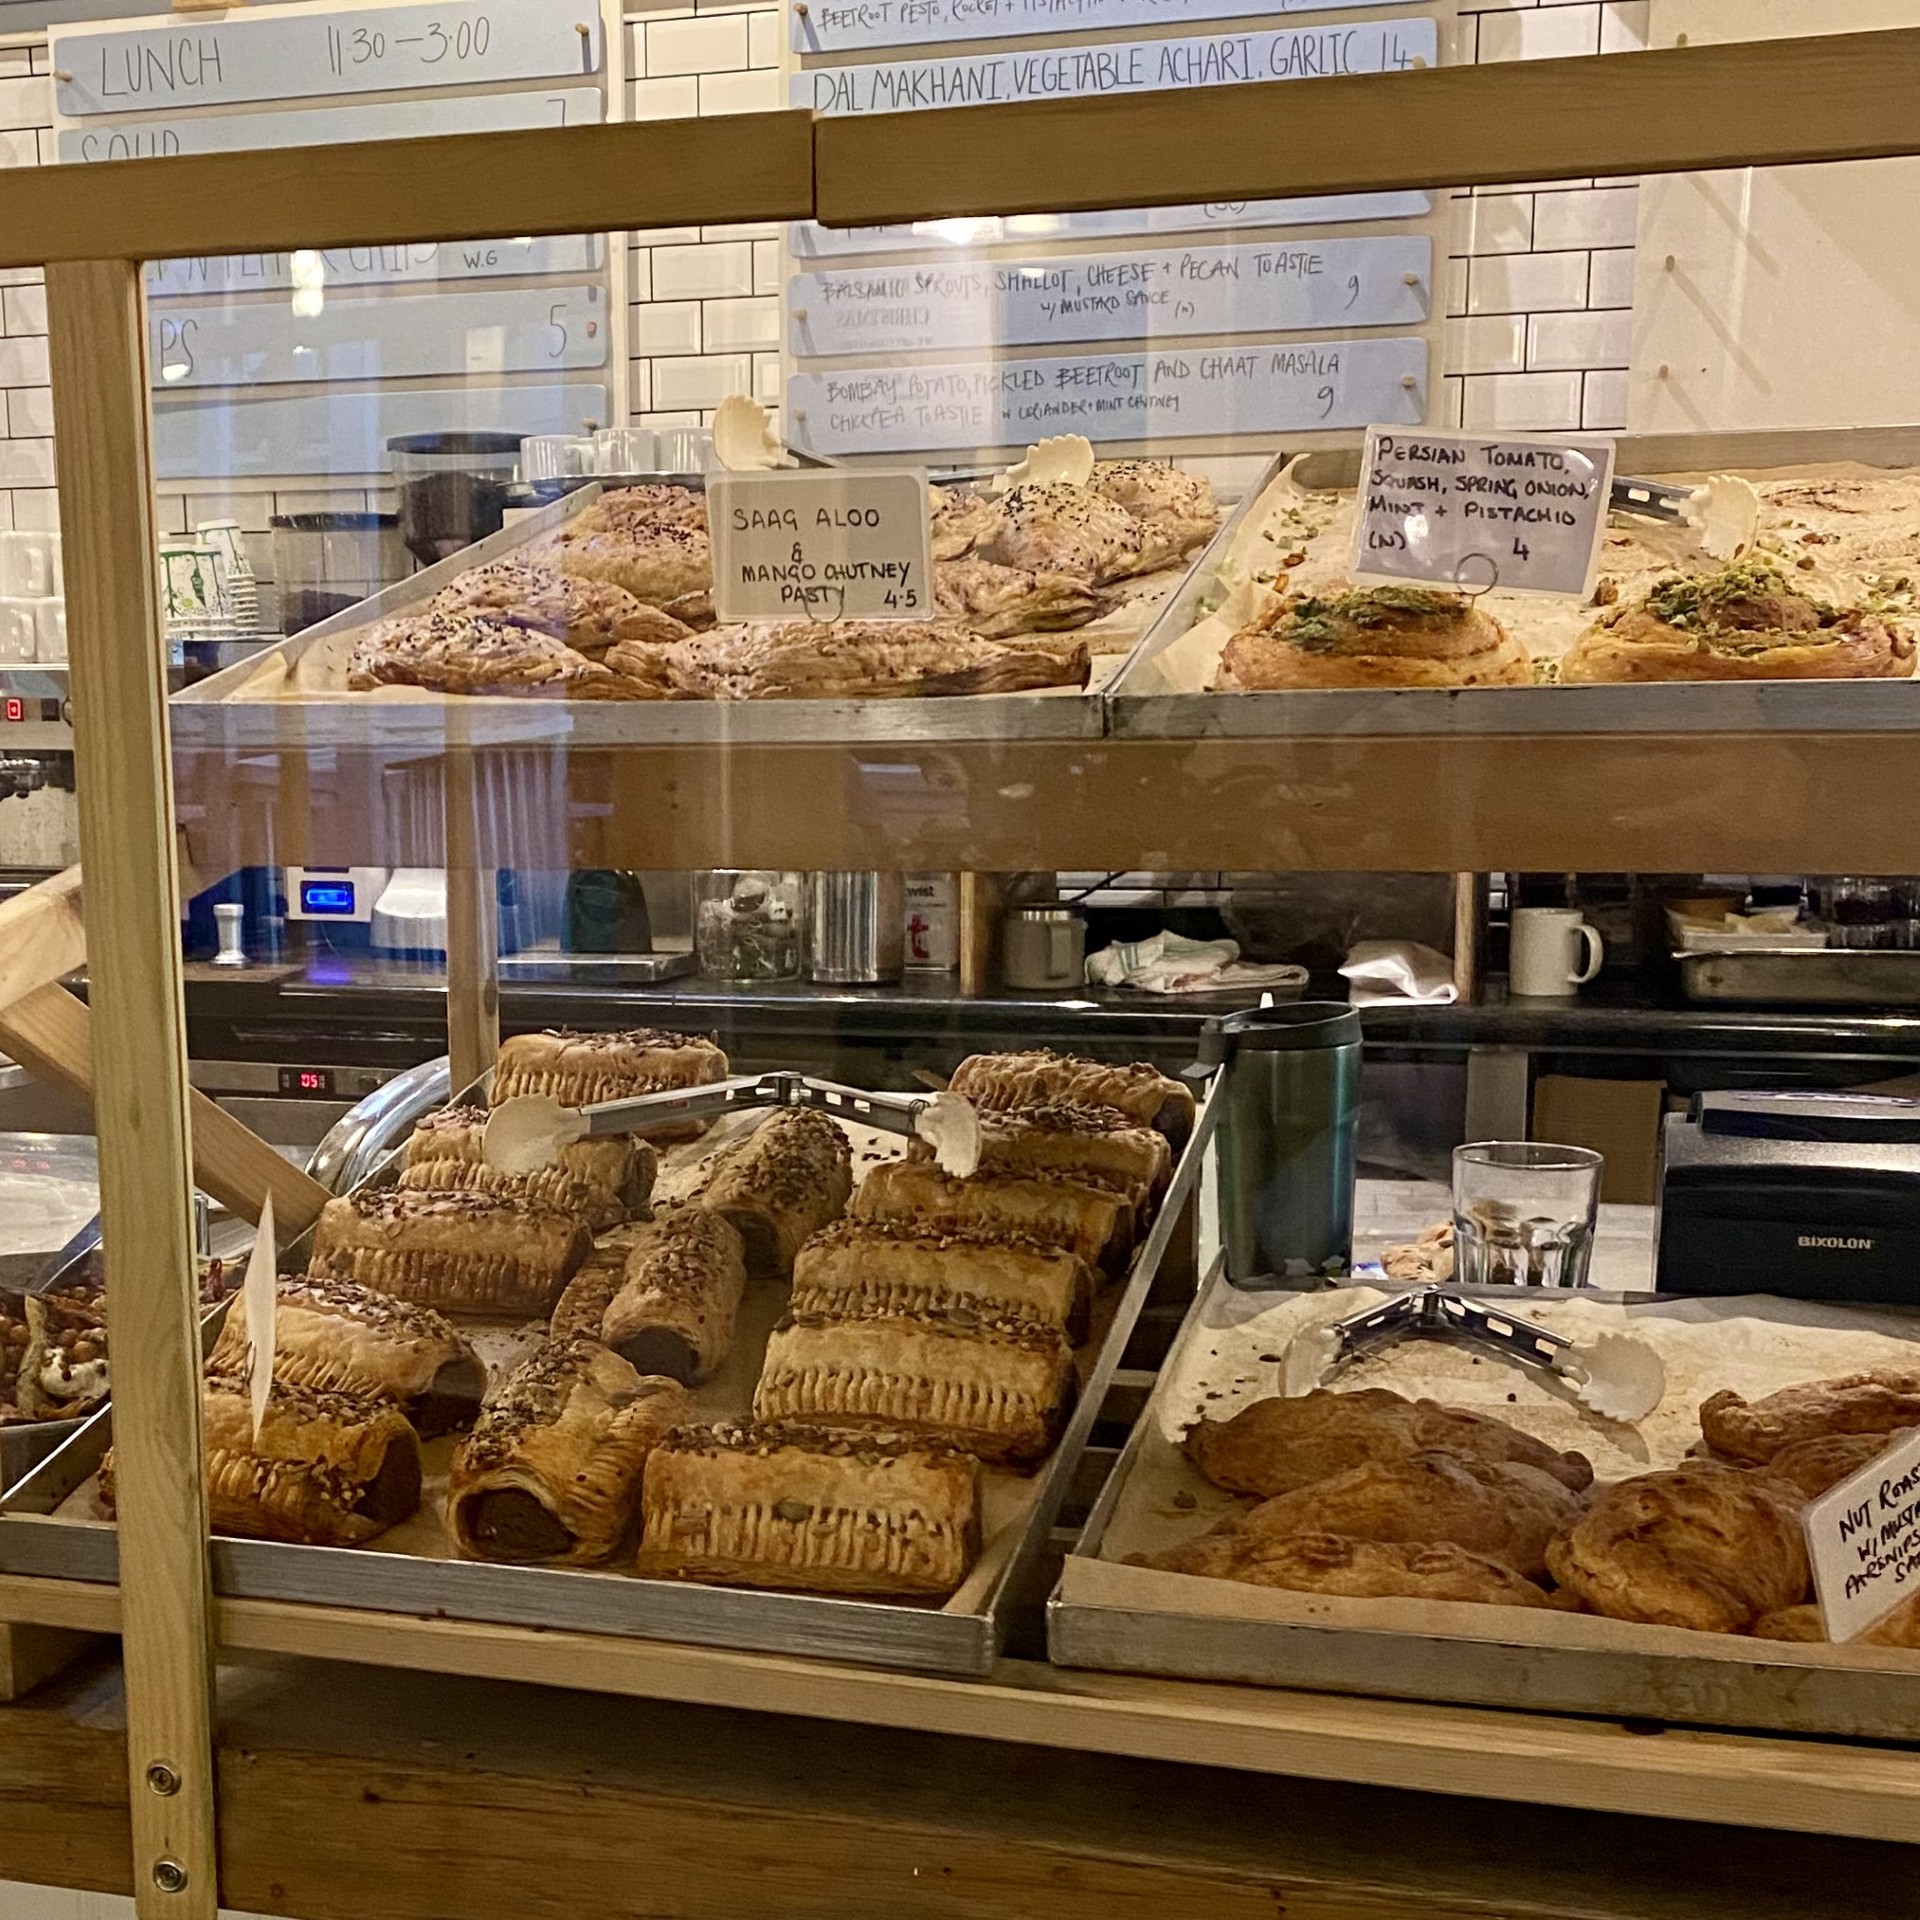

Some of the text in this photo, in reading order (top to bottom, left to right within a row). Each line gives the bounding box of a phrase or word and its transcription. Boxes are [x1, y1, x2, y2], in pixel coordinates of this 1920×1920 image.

[817, 2, 894, 31] BEETROOT
[101, 37, 222, 97] LUNCH
[814, 70, 863, 112] DAL
[1013, 48, 1144, 95] VEGETABLE
[1270, 30, 1359, 77] GARLIC
[1381, 30, 1413, 72] 14
[1087, 261, 1157, 287] CHEESE
[1180, 253, 1240, 281] PECAN
[1253, 251, 1324, 279] TOASTIE
[549, 304, 567, 359] 5
[159, 317, 199, 380] PS
[826, 377, 898, 405] BOMBAY
[1053, 361, 1145, 391] BEETROOT
[1154, 357, 1190, 383] AND
[1199, 354, 1259, 380] CHAAT
[1270, 350, 1340, 375] MASALA
[1317, 386, 1335, 418] 9
[1377, 436, 1570, 475] PERSIAN TOMATO,
[1454, 475, 1518, 500] SPRING
[1524, 480, 1590, 500] ONION,
[731, 508, 880, 531] SAAG ALOO
[1368, 495, 1426, 514] MINT
[1463, 501, 1576, 526] PISTACHIO
[791, 541, 804, 564] &
[1368, 530, 1408, 550] (N)
[1512, 537, 1530, 561] 4
[742, 561, 911, 588] MANGO CHUTNEY
[780, 584, 845, 603] PASTY
[904, 885, 935, 897] wist
[1838, 1461, 1920, 1543] NUT ROAS
